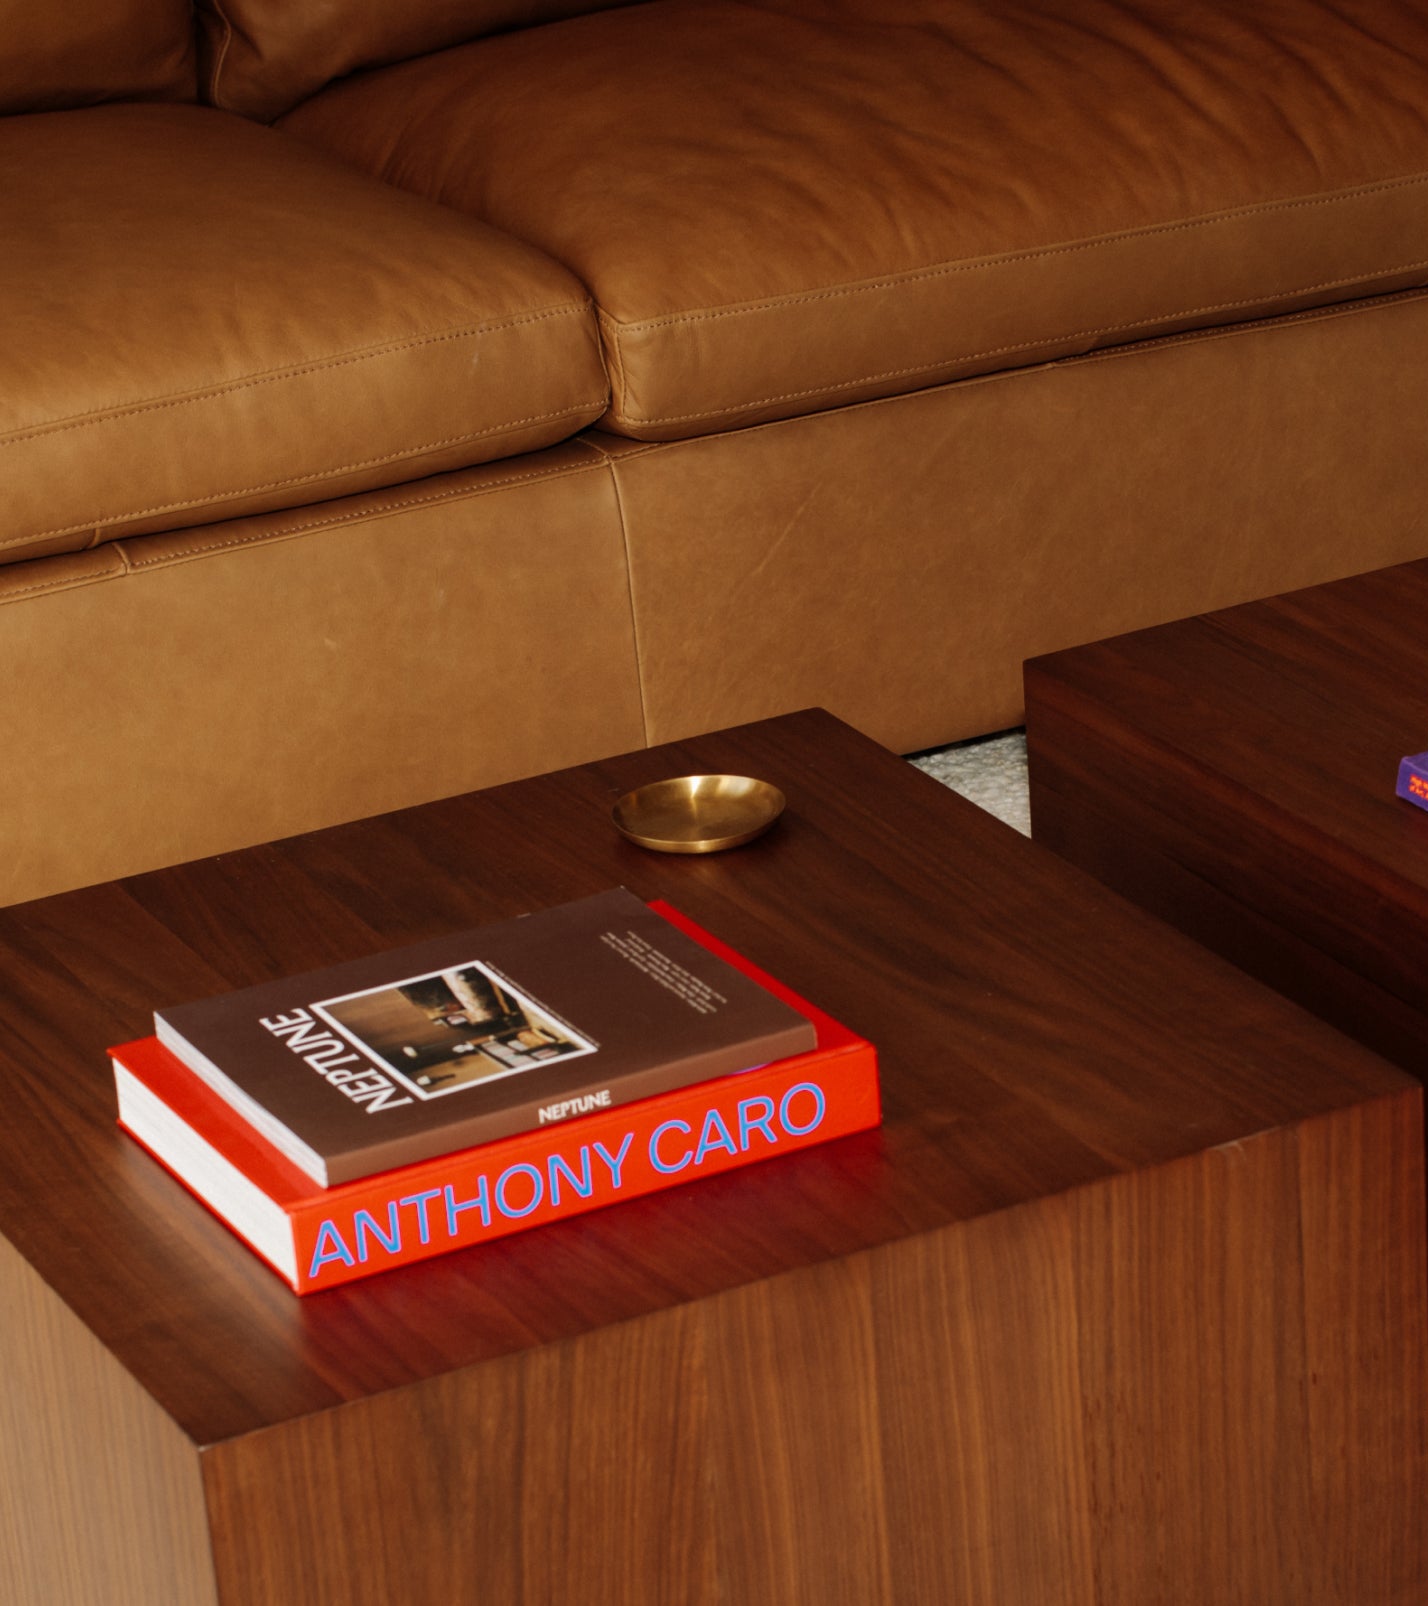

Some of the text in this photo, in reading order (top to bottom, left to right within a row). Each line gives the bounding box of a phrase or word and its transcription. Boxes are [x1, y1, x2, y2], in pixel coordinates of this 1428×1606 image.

[258, 1007, 415, 1114] NEPTUNE
[537, 1089, 612, 1124] NEPTUNE
[308, 1081, 827, 1279] ANTHONY CARO
